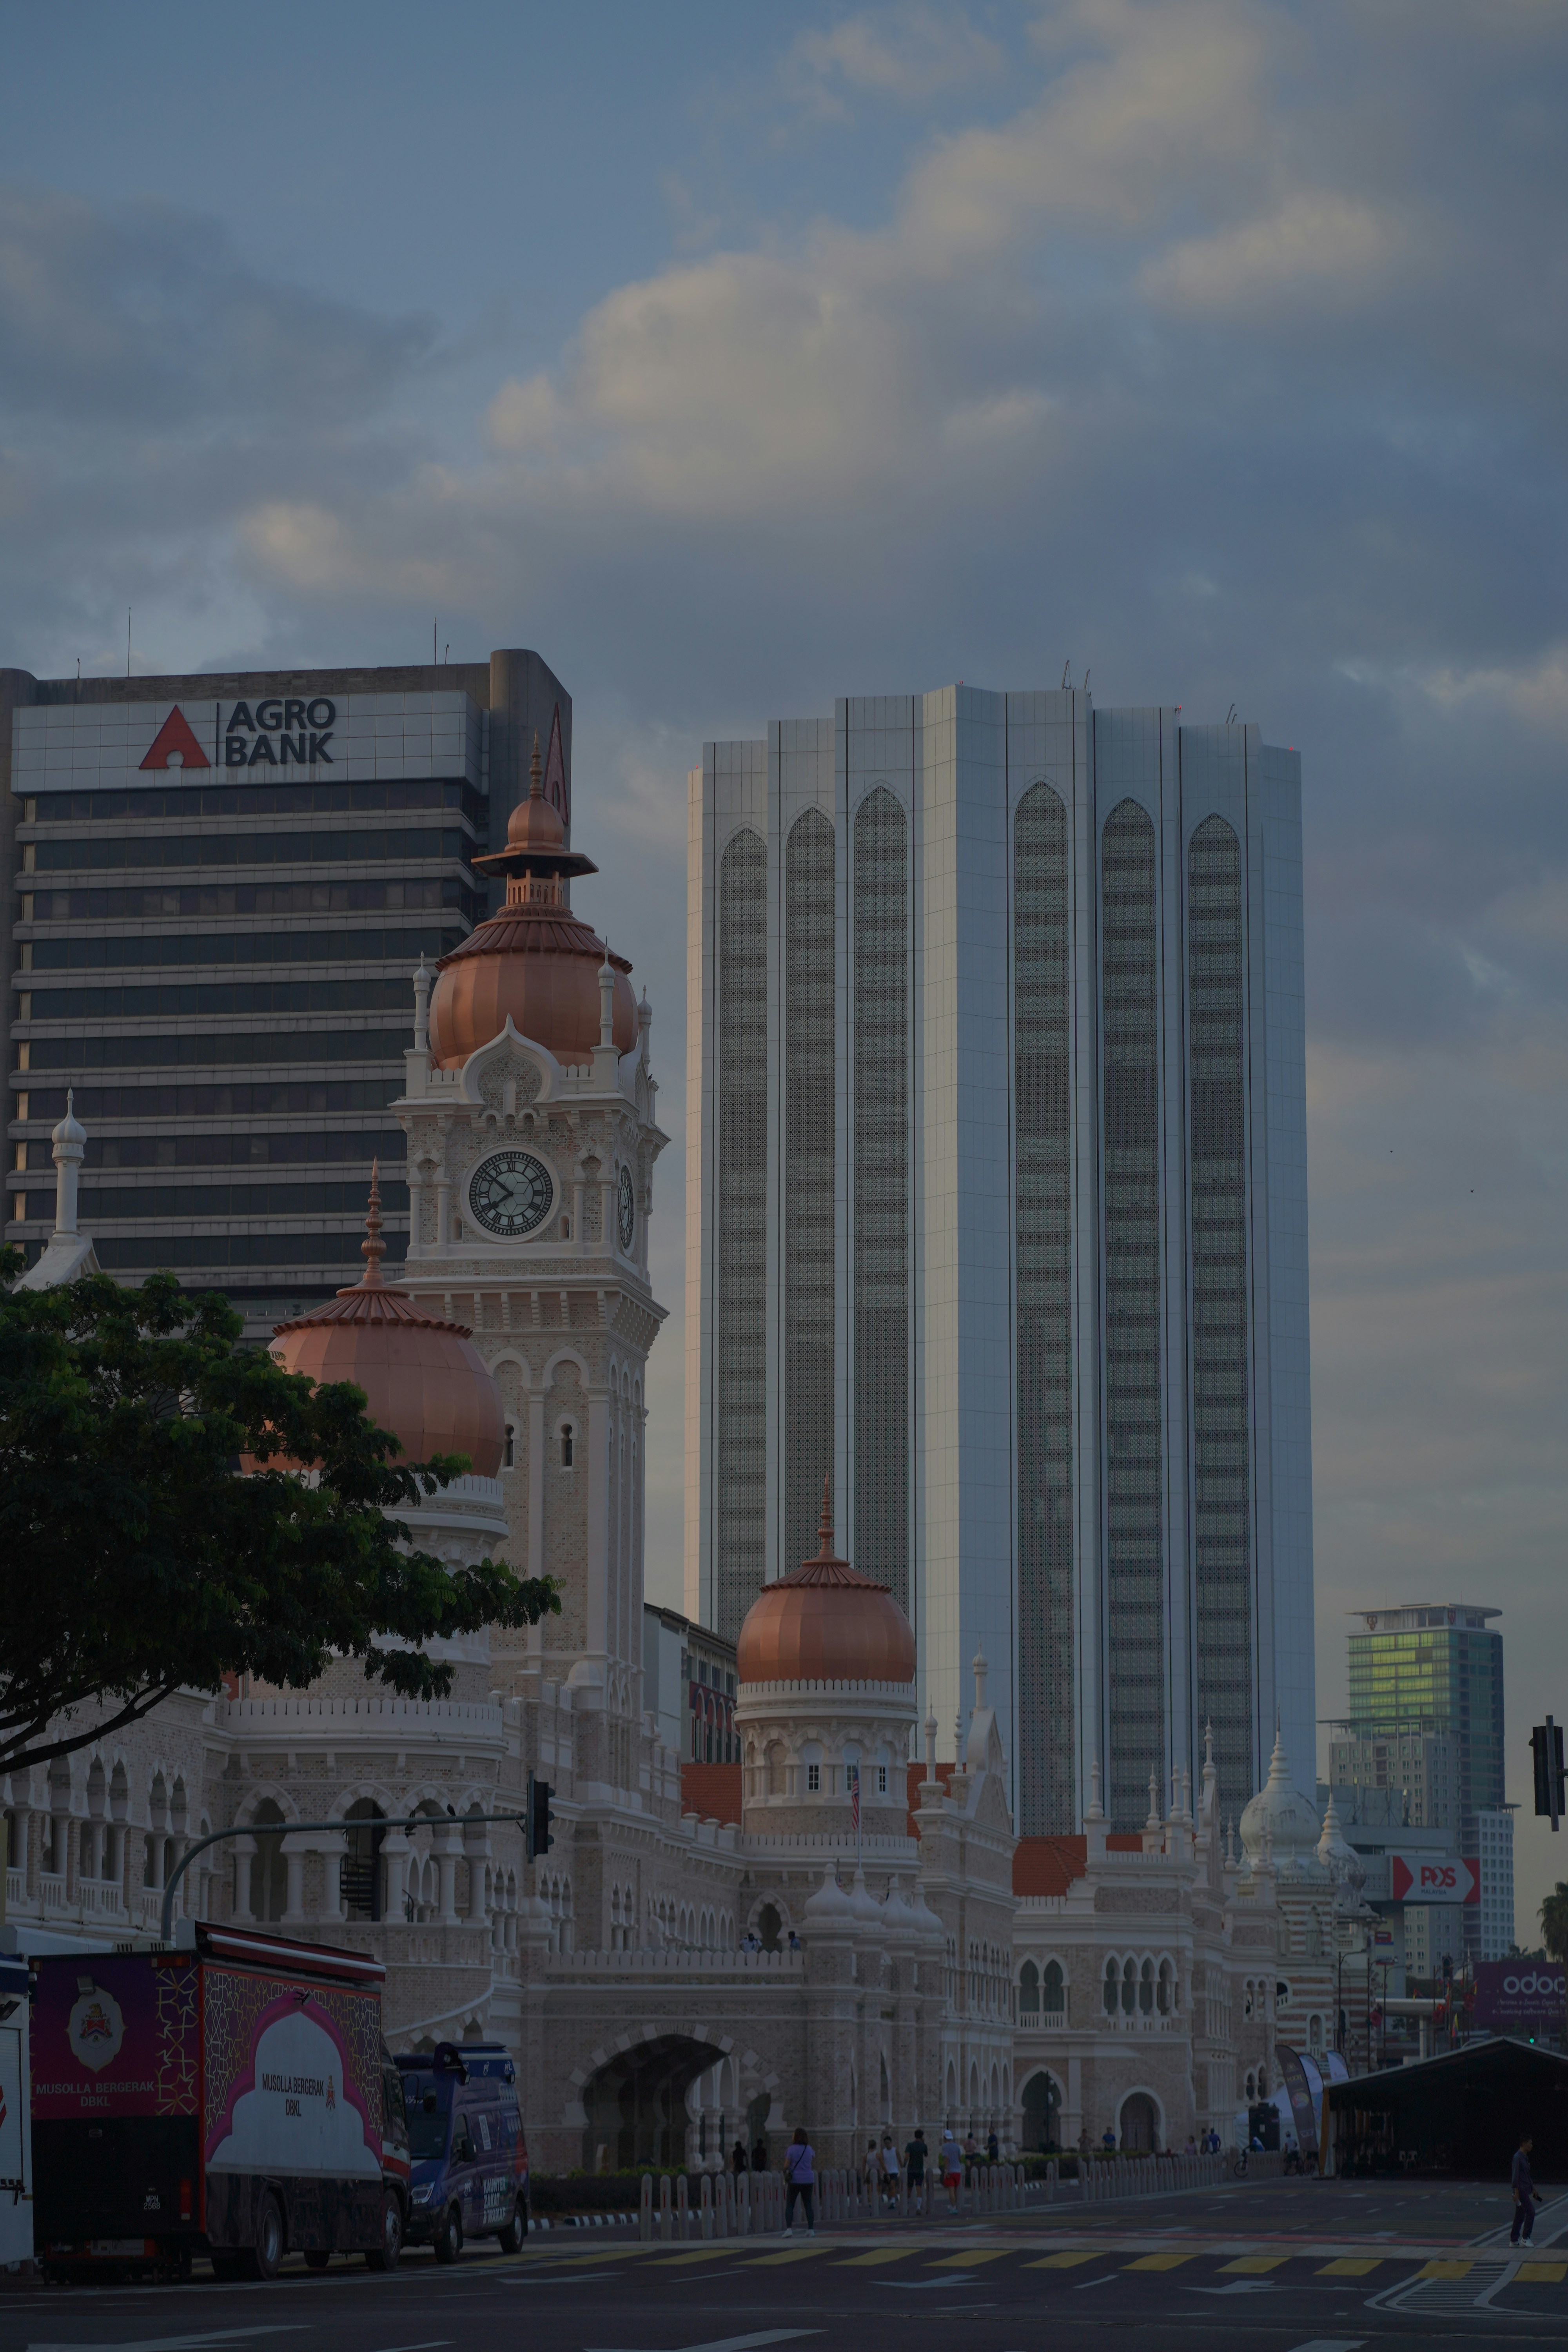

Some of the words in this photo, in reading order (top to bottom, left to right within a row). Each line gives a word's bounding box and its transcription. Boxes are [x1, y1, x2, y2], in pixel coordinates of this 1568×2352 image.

[226, 698, 336, 732] AGRO
[225, 732, 334, 766] BANK
[1421, 1866, 1456, 1887] POS
[36, 2083, 91, 2094] MUSOLLA
[96, 2081, 154, 2093] BERGERAK
[262, 2073, 292, 2093] MUSOLLA
[294, 2077, 324, 2096] BERGERAK
[80, 2096, 111, 2107] DBKL
[286, 2099, 301, 2117] DBKL
[483, 2176, 506, 2194] KAUNTER
[143, 2201, 160, 2210] 2568
[483, 2192, 500, 2210] ZAKAT
[487, 2207, 506, 2224] WAKAF
